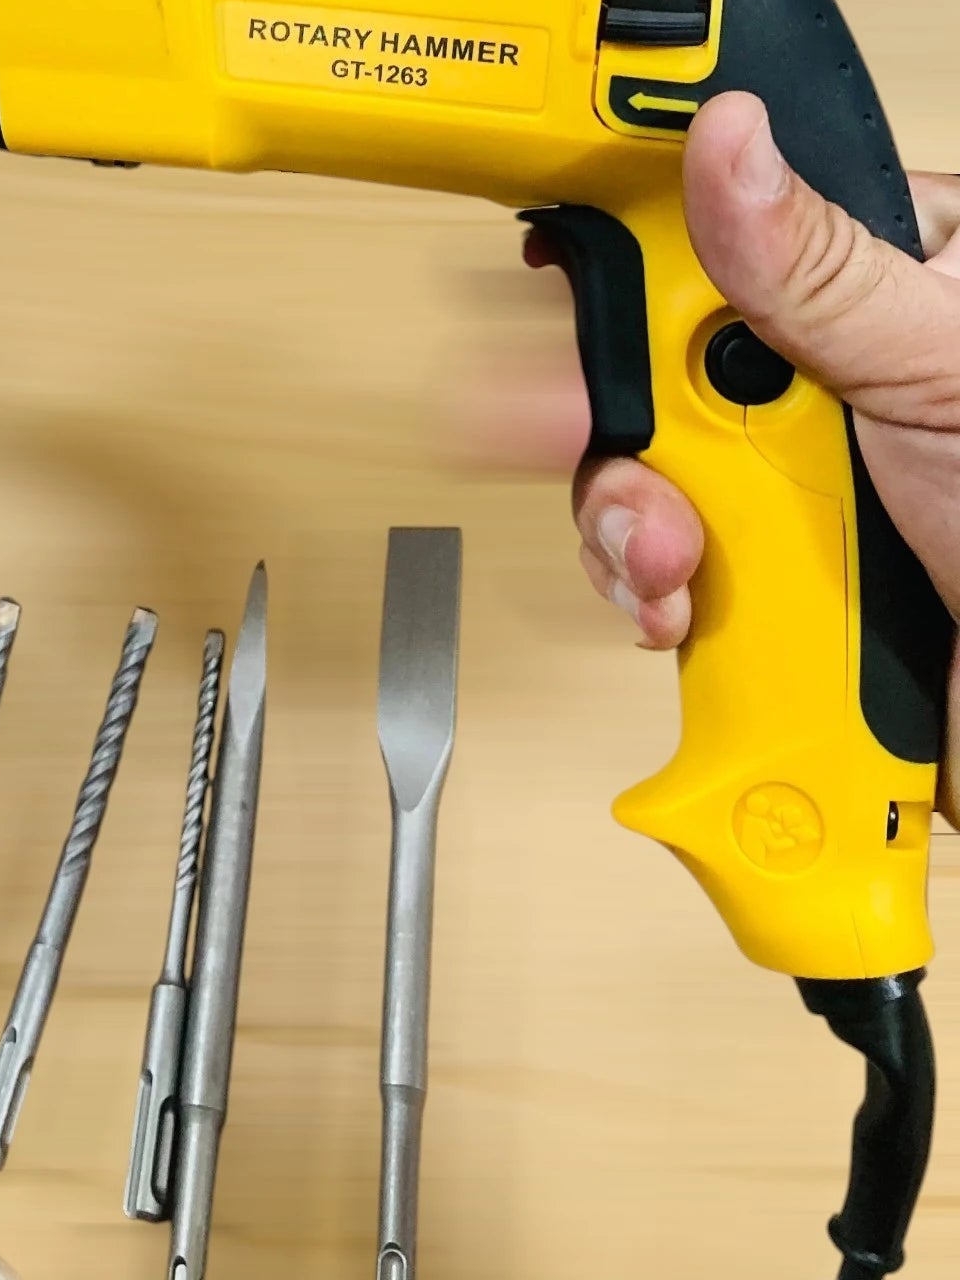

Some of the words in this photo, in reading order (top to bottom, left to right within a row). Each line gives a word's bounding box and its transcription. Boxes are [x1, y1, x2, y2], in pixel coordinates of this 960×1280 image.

[248, 17, 373, 52] ROTARY
[380, 30, 520, 66] HAMMER
[330, 58, 429, 87] GT-1263
